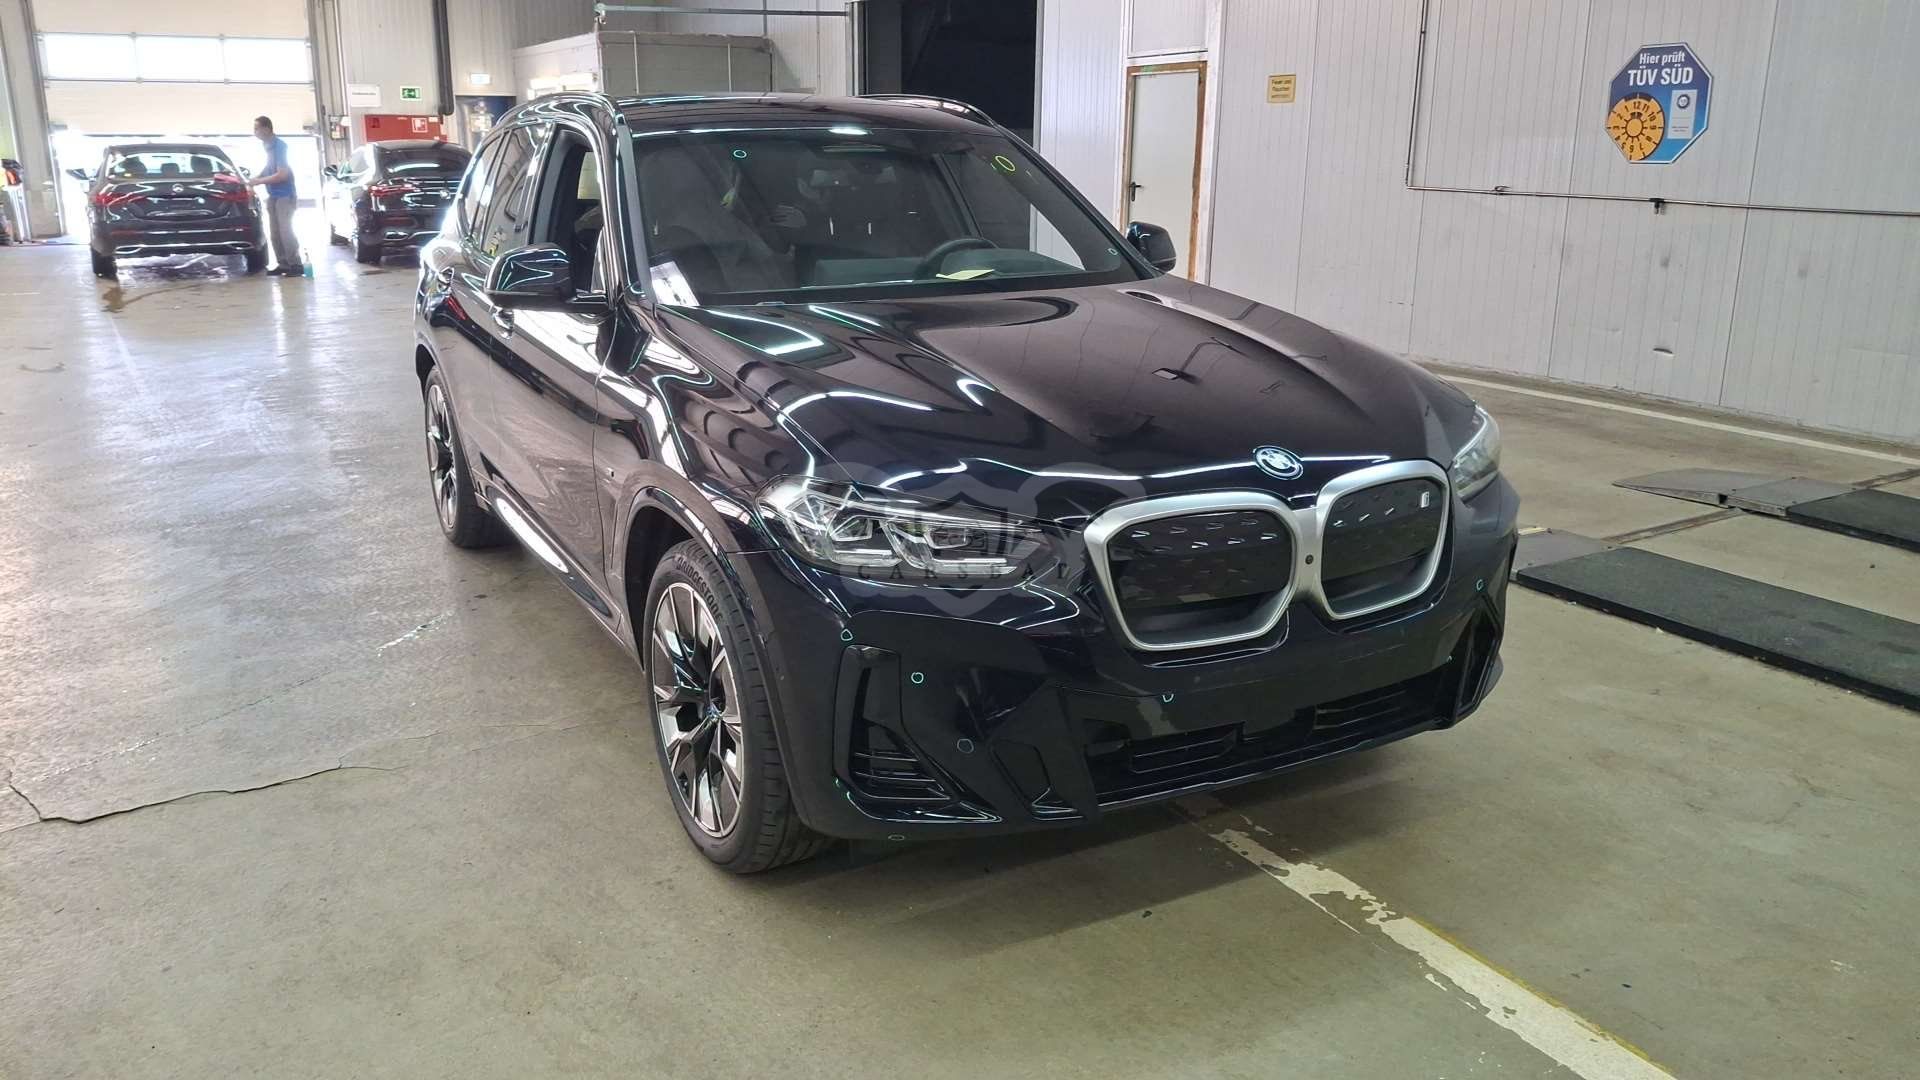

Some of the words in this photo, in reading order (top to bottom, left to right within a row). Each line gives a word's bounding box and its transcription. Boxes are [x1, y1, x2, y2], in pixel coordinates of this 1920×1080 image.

[1639, 52, 1660, 65] Hier
[1661, 51, 1686, 66] prüft
[1627, 65, 1659, 86] TÜV
[1660, 63, 1694, 85] SÜD
[1633, 101, 1641, 110] 12
[1642, 103, 1650, 113] 11
[1647, 112, 1657, 122] 10
